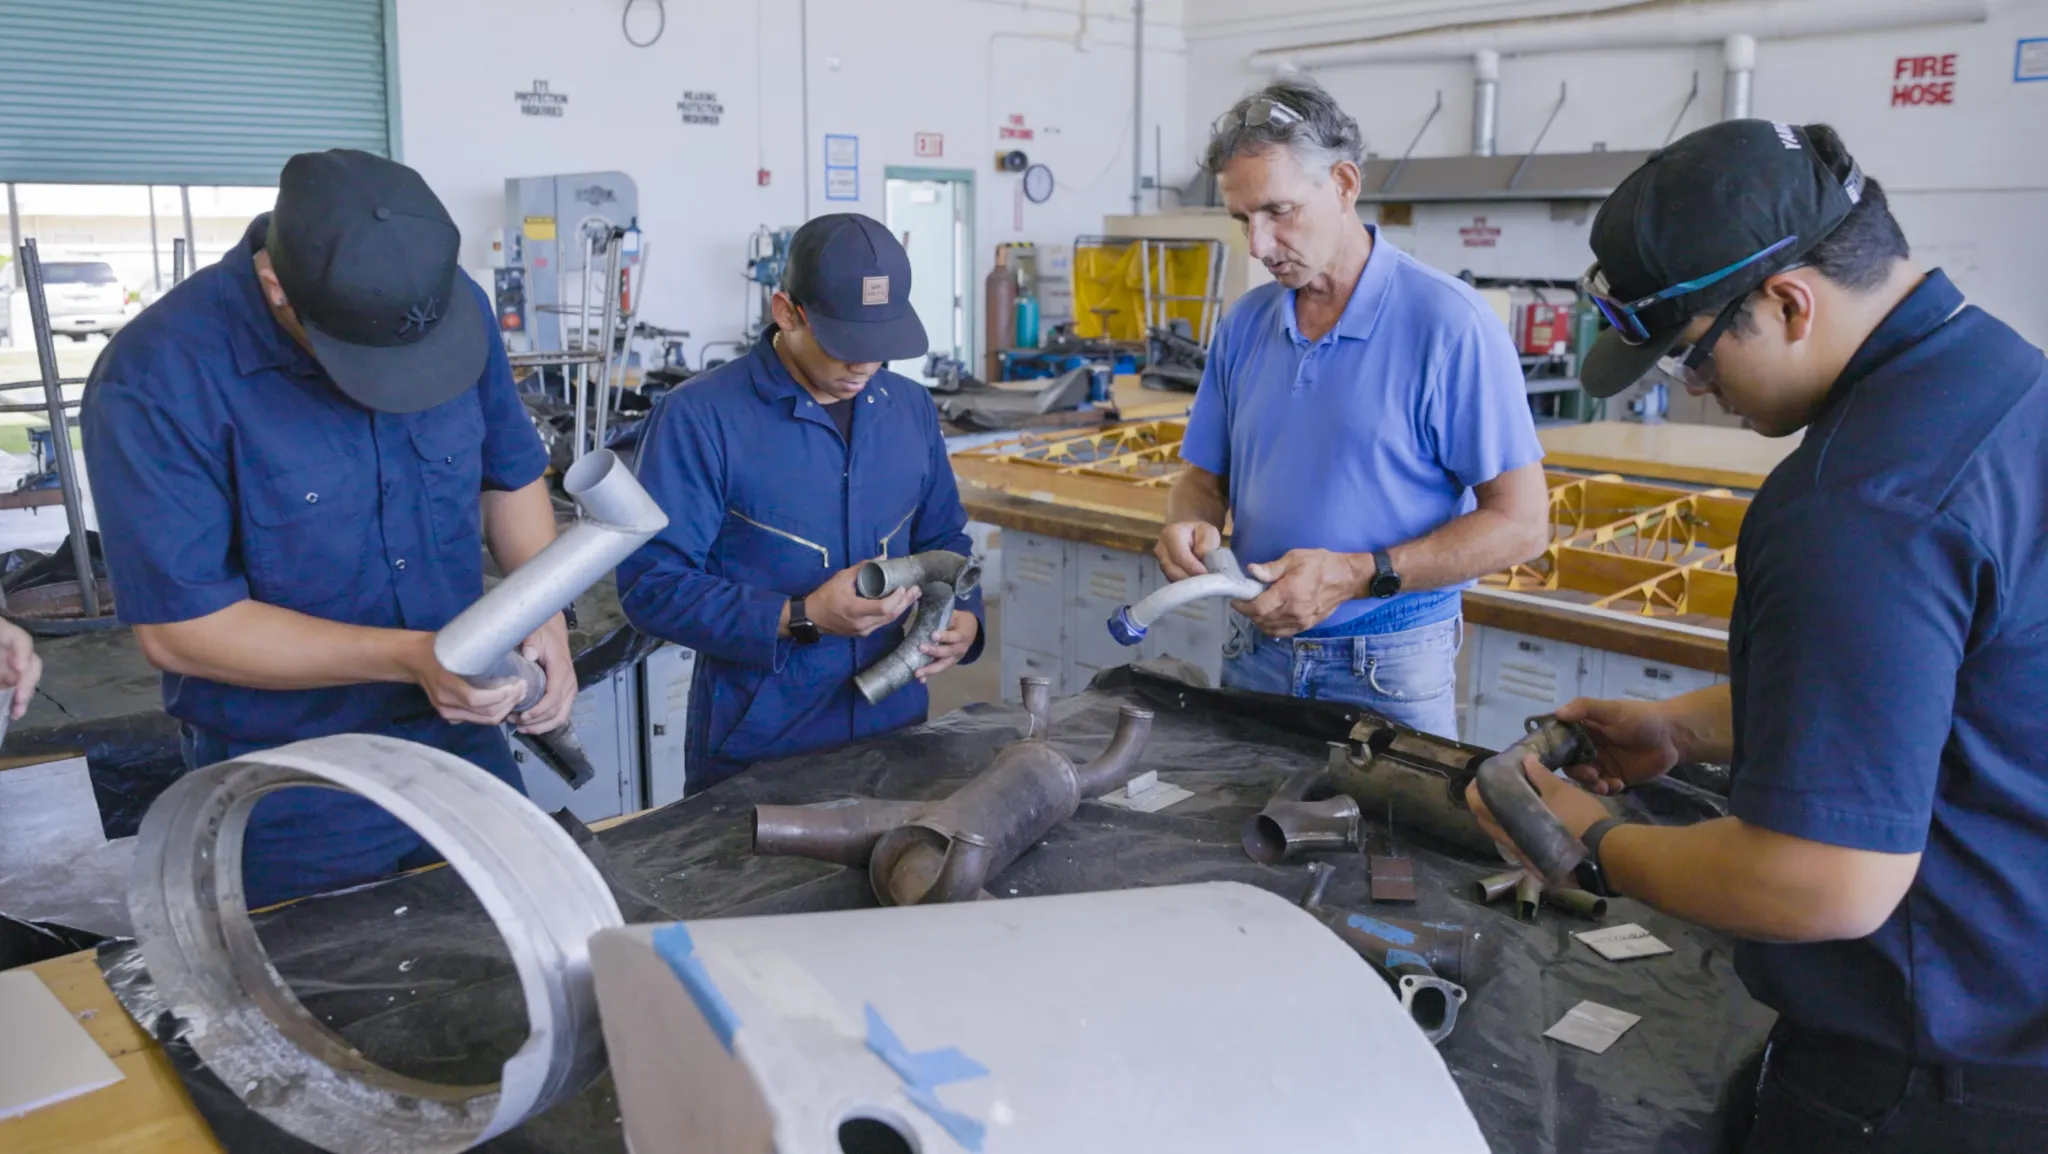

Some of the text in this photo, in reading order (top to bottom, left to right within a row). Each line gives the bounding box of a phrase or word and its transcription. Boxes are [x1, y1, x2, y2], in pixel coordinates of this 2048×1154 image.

[1895, 54, 1957, 79] FIRE
[514, 91, 568, 104] PROTECTION
[1891, 82, 1954, 107] HOSE
[521, 105, 564, 117] REQUIRED
[677, 102, 724, 114] PROTECTION
